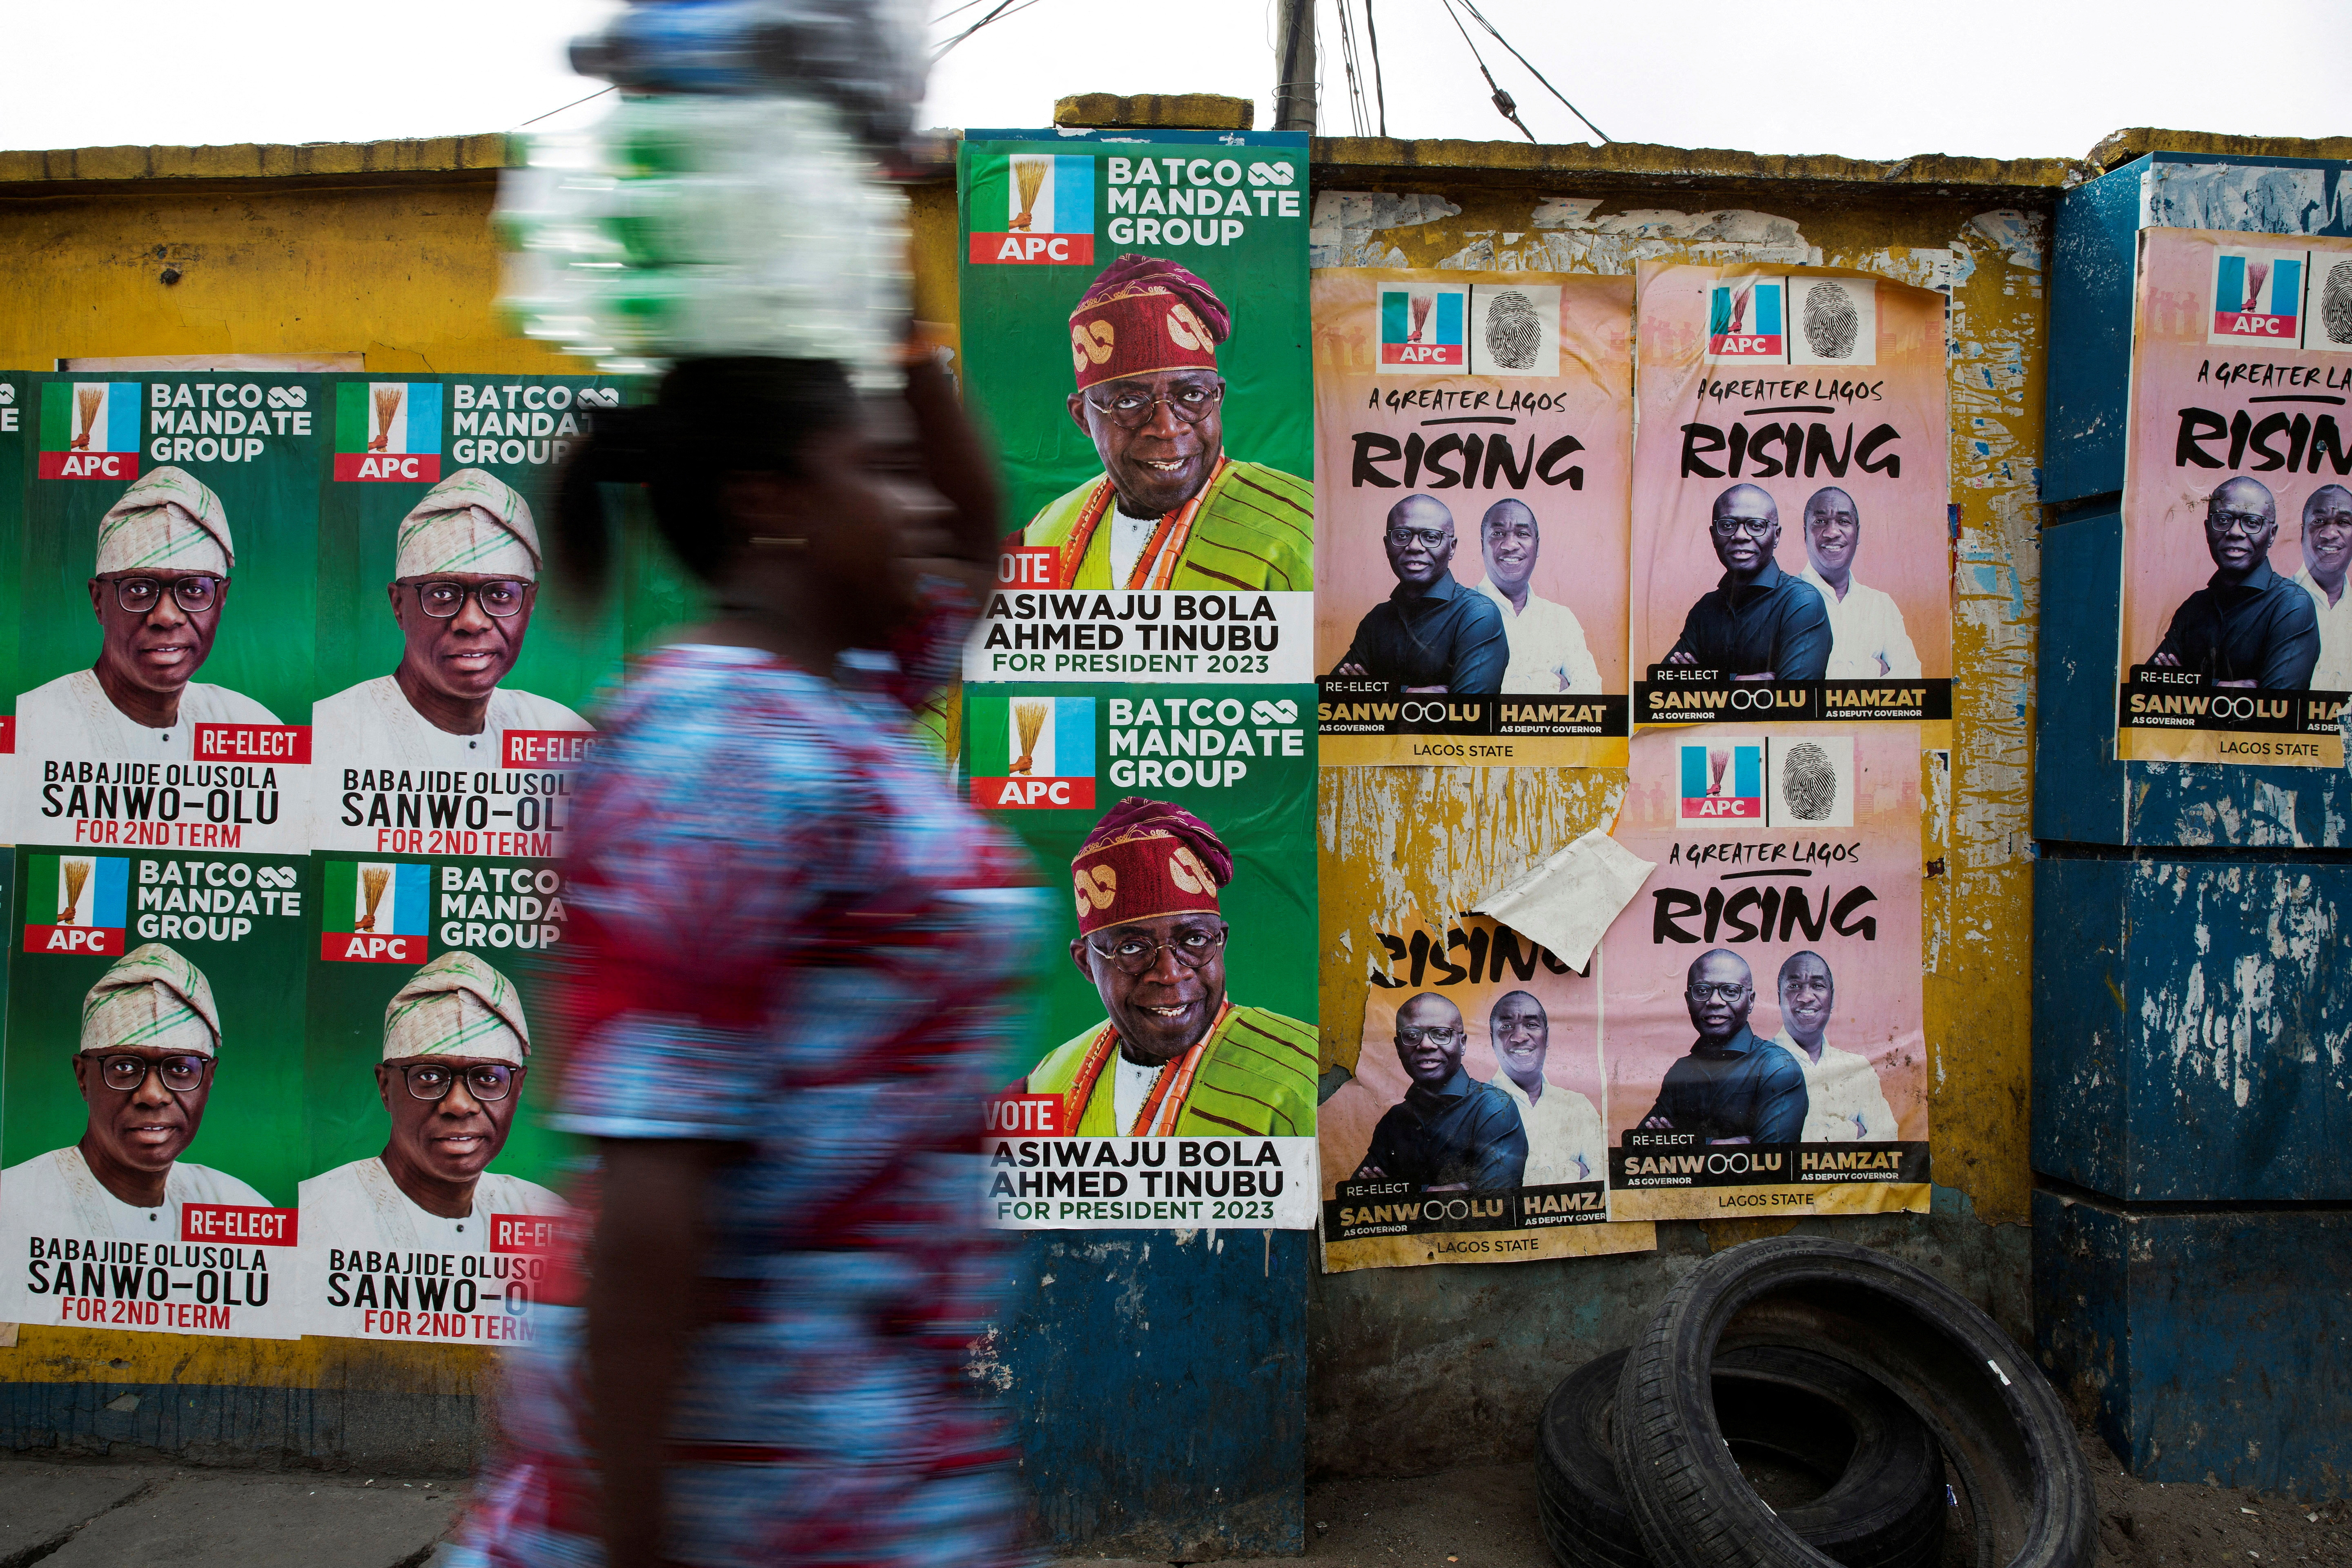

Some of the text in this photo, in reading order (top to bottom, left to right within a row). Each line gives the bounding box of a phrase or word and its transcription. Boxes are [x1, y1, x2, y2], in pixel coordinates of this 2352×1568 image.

[1108, 158, 1242, 186] BATCO
[1108, 188, 1301, 217] MANDATE
[1108, 218, 1244, 246] GROUP
[997, 238, 1068, 261] APC
[2232, 316, 2280, 334] APC
[1400, 347, 1446, 362] APC
[1721, 338, 1766, 353] APC
[2197, 359, 2209, 385] A
[2215, 362, 2321, 390] GREATER
[151, 384, 262, 408] BATCO
[454, 385, 572, 409] BATCO
[1369, 388, 1567, 416] A GREATER LAGOS
[1697, 379, 1884, 405] A GREATER LAGOS
[151, 411, 312, 435] MANDATE
[151, 438, 264, 462] GROUP
[453, 439, 571, 464] GROUP
[1681, 422, 1901, 478] RISING
[2176, 407, 2352, 475] RISIN
[61, 456, 119, 476] APC
[358, 458, 418, 478] APC
[1352, 432, 1585, 490] RISING
[998, 553, 1050, 583] OTE
[986, 594, 1277, 621] ASIWAJU BOLA
[984, 624, 1279, 651] AHMED TINUBU
[993, 654, 1269, 674] FOR PRESIDENT 2023
[1657, 670, 1719, 680] RE-ELECT
[1326, 682, 1389, 692] RE-ELECT
[2141, 672, 2201, 684] RE-ELECT
[1826, 689, 1926, 707] HAMZAT
[1110, 699, 1244, 726] BATCO
[1501, 704, 1606, 722] HAMZAT
[2146, 717, 2195, 726] GOVERNOR
[203, 730, 297, 756] RE-ELECT
[511, 737, 596, 762] RE-ELEC
[1110, 729, 1304, 756] MANDATE
[1414, 744, 1513, 757] LAGOS STATE
[2220, 742, 2319, 756] LAGOS STATE
[45, 761, 276, 788] BABAJIDE OLUSOLA
[344, 769, 570, 796] BABAJIDE OLUSOL
[1109, 760, 1247, 788] GROUP
[42, 784, 278, 824] SANWO-OLU
[998, 782, 1070, 805] APC
[342, 793, 572, 831] SANWO-OL
[1699, 800, 1744, 815] APC
[76, 820, 241, 848] FOR 2ND TERM
[377, 829, 552, 856] FOR 2ND TERM
[1669, 841, 1860, 869] A GREATER LAGOS
[139, 860, 252, 888] BATCO
[442, 866, 559, 894] BATCO
[138, 887, 301, 916] MANDATE
[441, 894, 568, 921] MANDA
[1653, 884, 1878, 944] RISING
[47, 929, 104, 951] APC
[137, 914, 252, 941] GROUP
[441, 922, 560, 949] GROUP
[345, 938, 406, 960] APC
[982, 1100, 1054, 1131] VOTE
[1633, 1135, 1695, 1145] RE-ELECT
[990, 1141, 1281, 1167] ASIWAJU BOLA
[1801, 1152, 1902, 1170] HAMZAT
[989, 1171, 1284, 1198] AHMED TINUBU
[1347, 1183, 1410, 1196] RE-ELECT
[1641, 1177, 1692, 1185] GOVERNOR
[998, 1201, 1274, 1220] FOR PRESIDENT 2023
[1719, 1194, 1814, 1207] LAGOS STATE
[191, 1210, 286, 1238] RE-ELECT
[1356, 1225, 1408, 1235] GOVERNOR
[1525, 1213, 1606, 1226] AS DEPUTY GOVER
[30, 1237, 266, 1271] BABAJIDE OLUSOLA
[1438, 1238, 1539, 1254] LAGOS STATE
[330, 1249, 544, 1281] BABAJIDE OLUSO
[28, 1260, 269, 1307] SANWO-OLU
[62, 1296, 230, 1330] FOR 2ND TERM
[365, 1310, 411, 1335] FOR
[416, 1312, 466, 1337] 2ND
